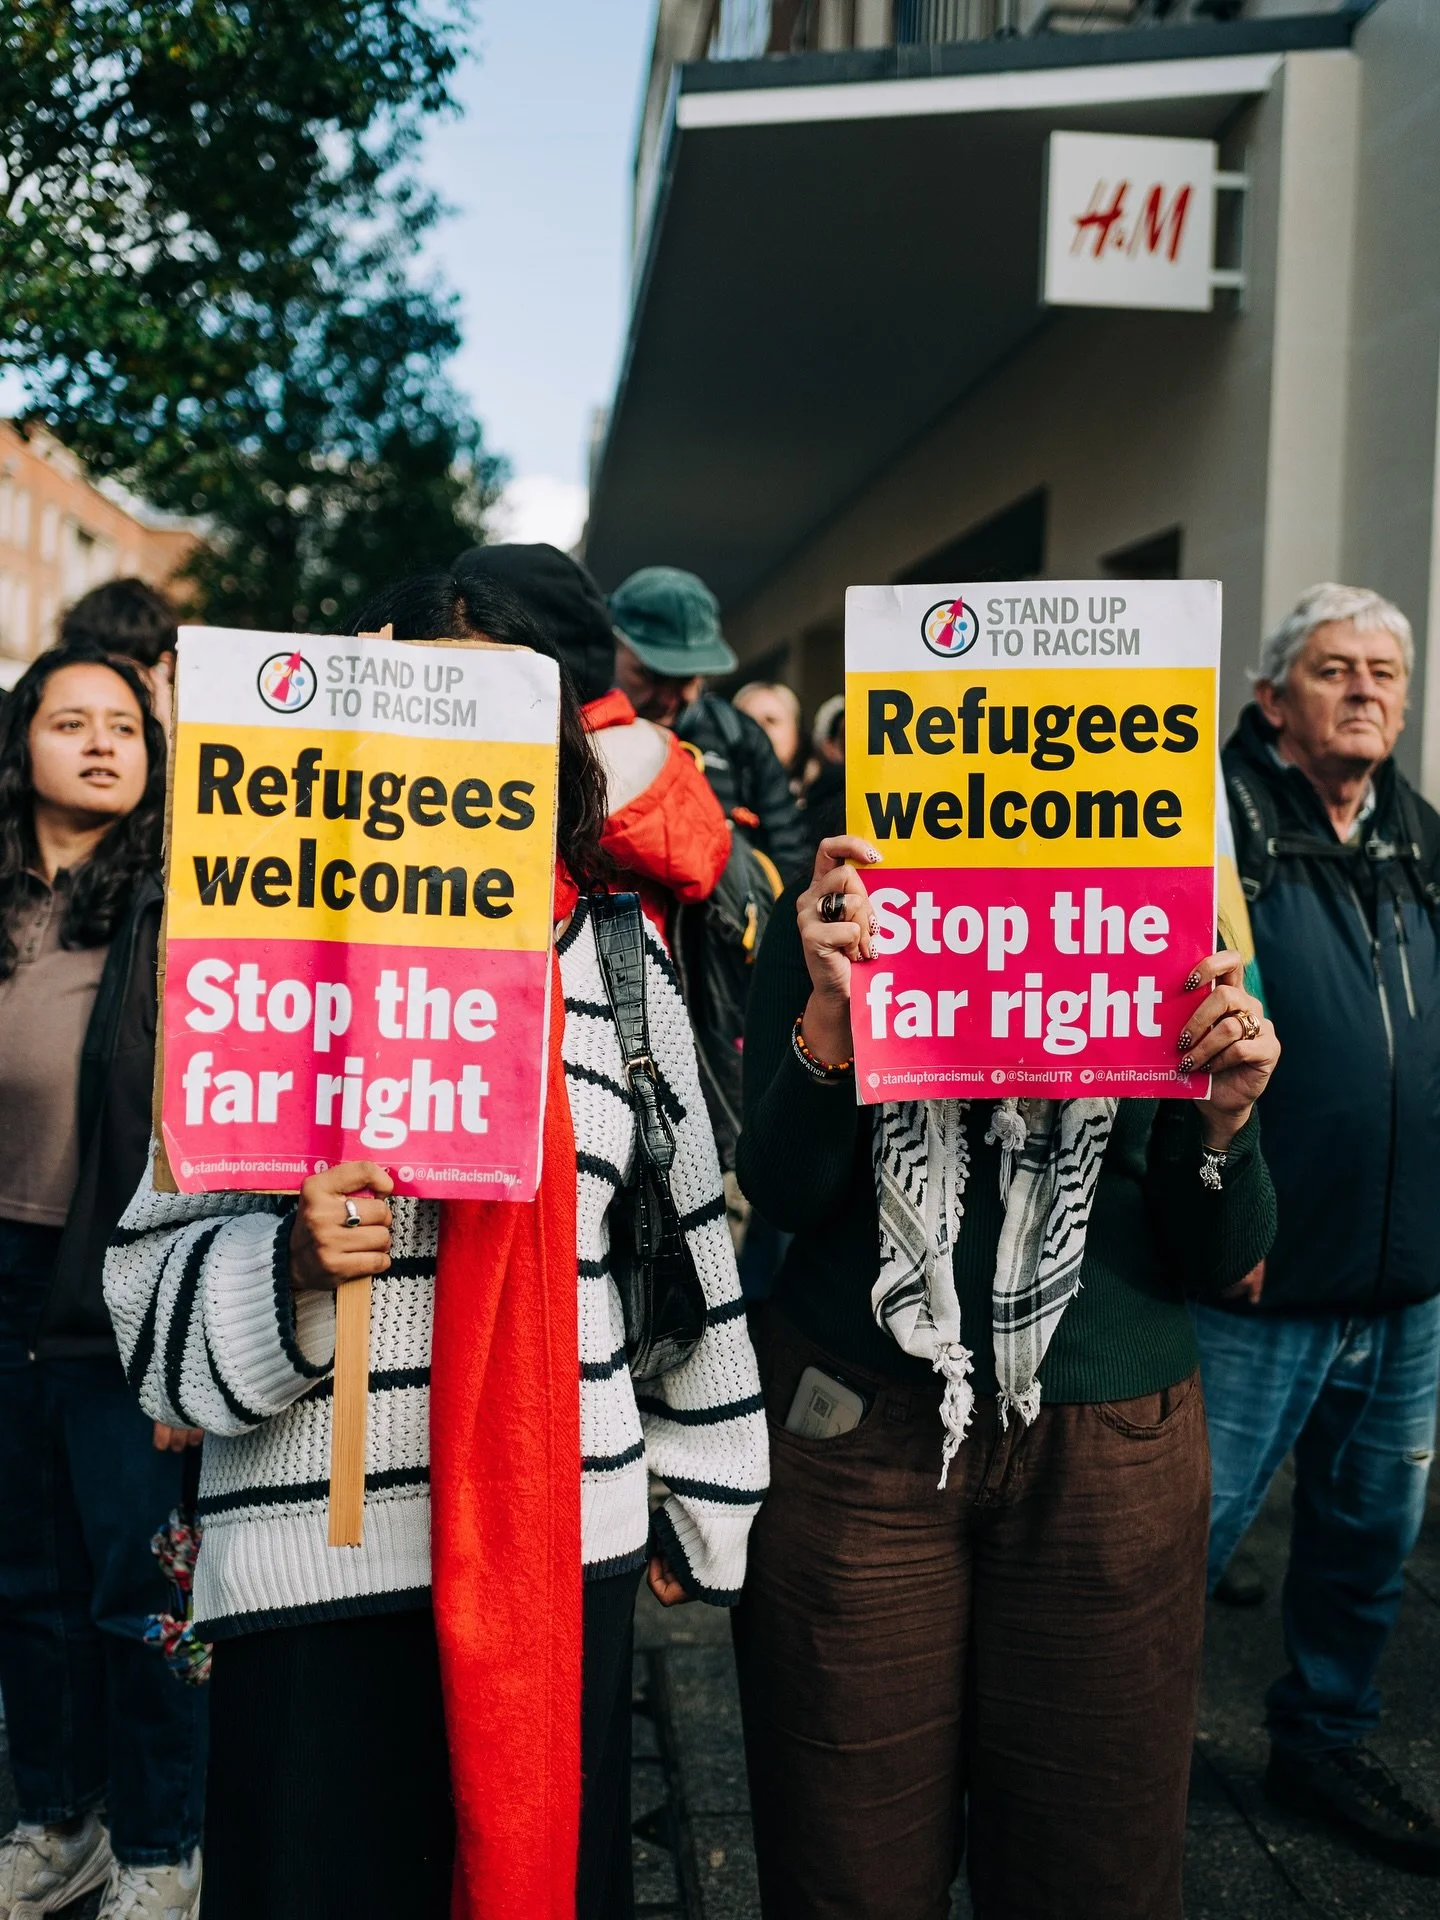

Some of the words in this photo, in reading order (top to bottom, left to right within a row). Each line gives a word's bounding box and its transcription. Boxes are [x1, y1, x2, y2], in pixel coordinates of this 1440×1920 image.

[1070, 178, 1193, 263] H&M
[986, 597, 1079, 625] STAND
[1088, 596, 1126, 624] UP
[987, 628, 1024, 657] TO
[1034, 627, 1140, 656] RACISM
[325, 688, 362, 718] TO
[372, 692, 477, 728] RACISM
[326, 655, 415, 688] STAND
[423, 665, 464, 694] UP
[867, 687, 1199, 771] Refugees
[197, 743, 536, 841] Refugees
[865, 772, 1183, 840] welcome
[193, 838, 515, 919] welcome
[868, 887, 1029, 971] Stop
[1050, 888, 1170, 955] the
[184, 958, 353, 1052] Stop
[374, 967, 498, 1042] the
[866, 972, 968, 1039] far
[991, 972, 1163, 1055] right
[182, 1051, 293, 1125] far
[315, 1056, 490, 1150] right
[882, 1070, 985, 1085] standuptoracismuk
[1007, 1070, 1073, 1083] @StandUTR
[1095, 1069, 1190, 1084] @AntiRacismDay
[194, 1159, 308, 1174] standuptoracismuk
